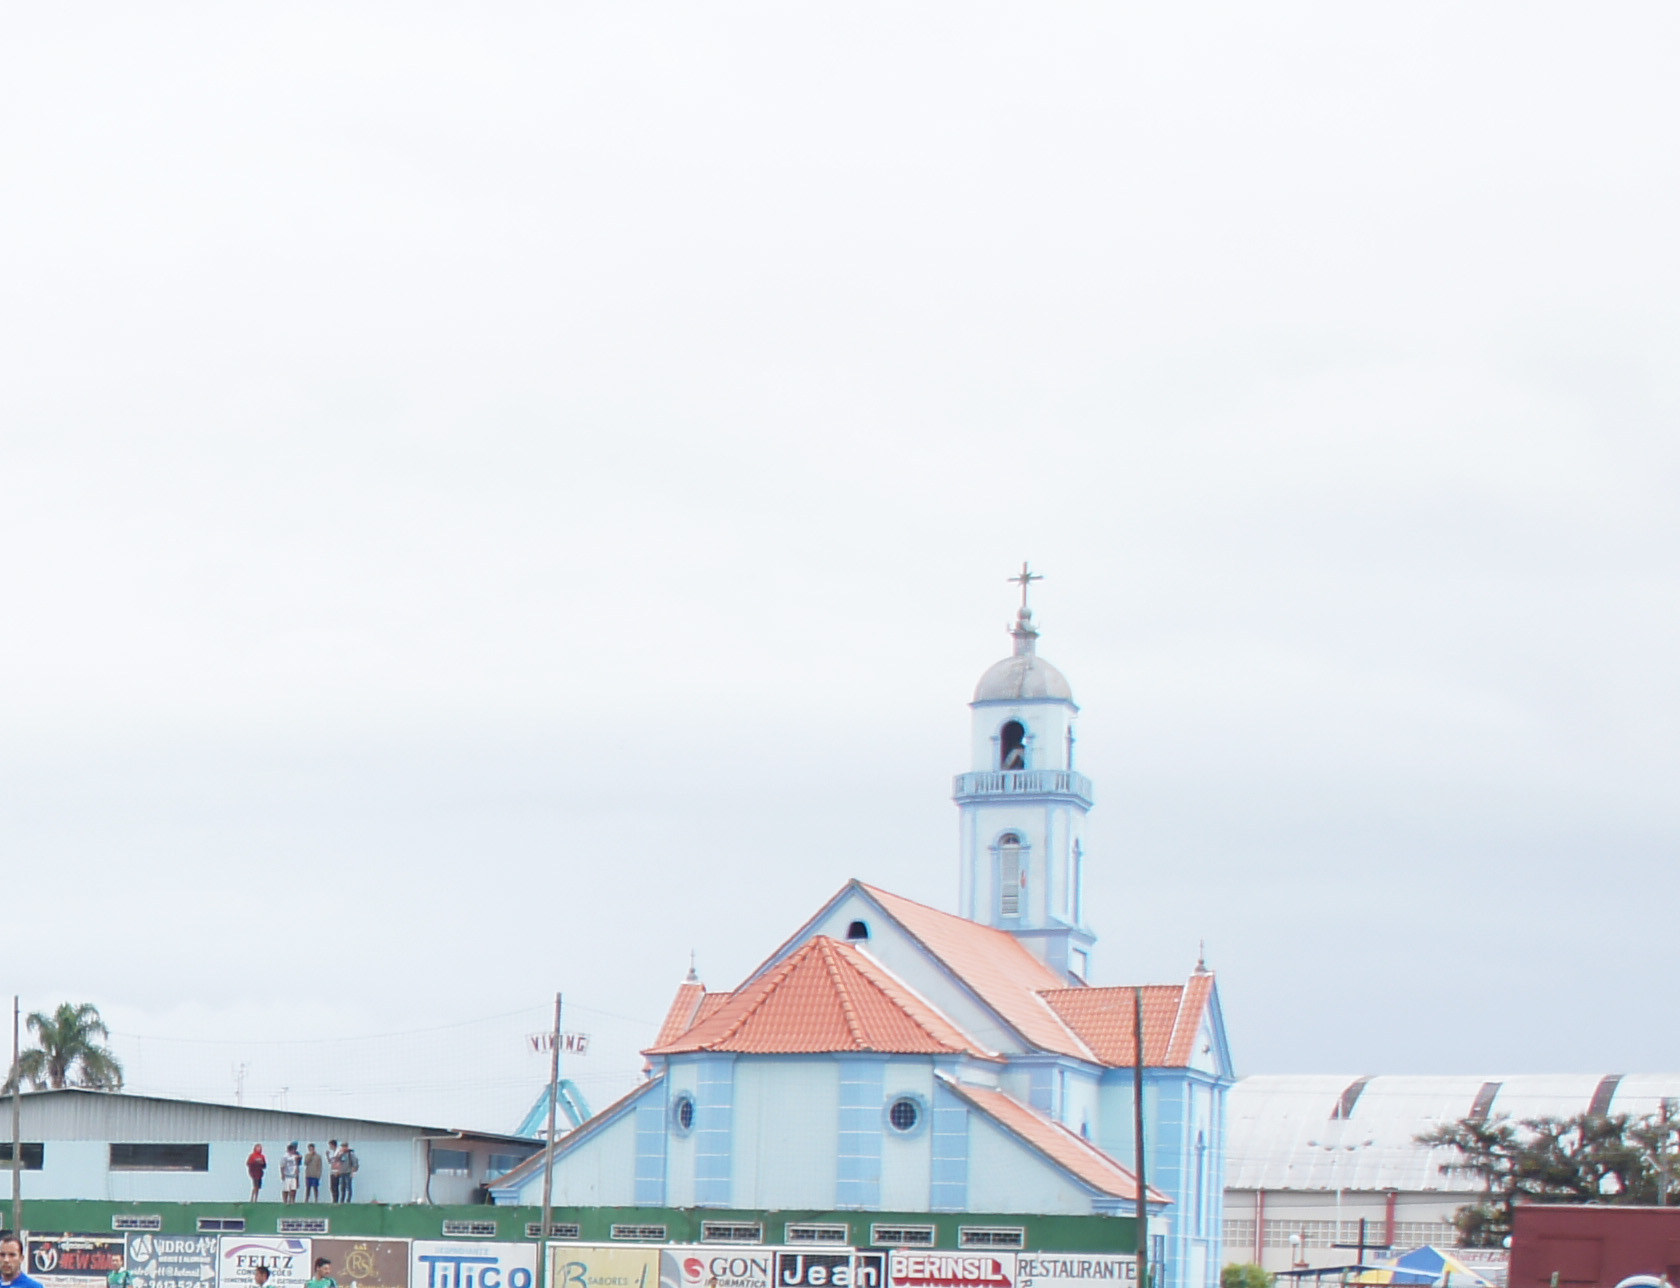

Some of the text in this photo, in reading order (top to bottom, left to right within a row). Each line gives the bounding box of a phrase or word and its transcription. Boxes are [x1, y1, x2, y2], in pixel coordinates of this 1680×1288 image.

[236, 1255, 293, 1269] FELTZ
[709, 1257, 768, 1278] GON
[783, 1255, 878, 1287] Jean
[891, 1255, 1007, 1284] BERINSIL
[1018, 1259, 1137, 1280] RESTAURANTE
[588, 1277, 628, 1286] SABORES
